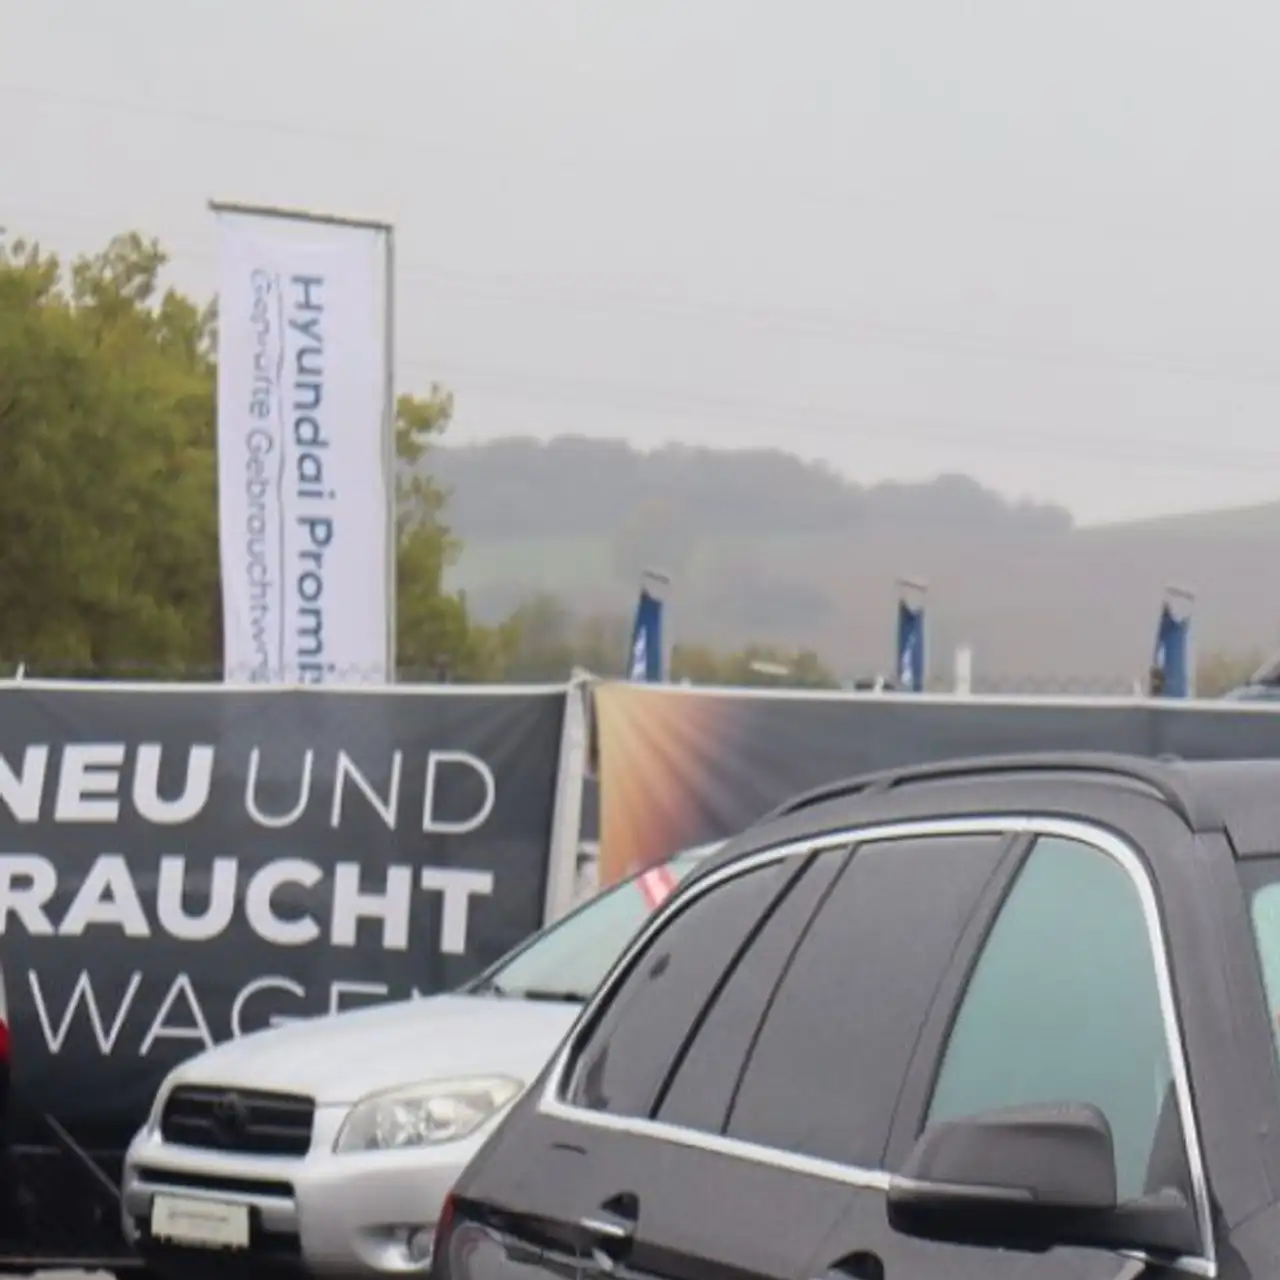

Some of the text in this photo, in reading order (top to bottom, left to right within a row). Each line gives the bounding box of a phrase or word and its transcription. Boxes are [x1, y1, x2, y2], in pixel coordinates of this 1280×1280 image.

[288, 275, 337, 499] Hyundai
[0, 743, 497, 834] NEU UND
